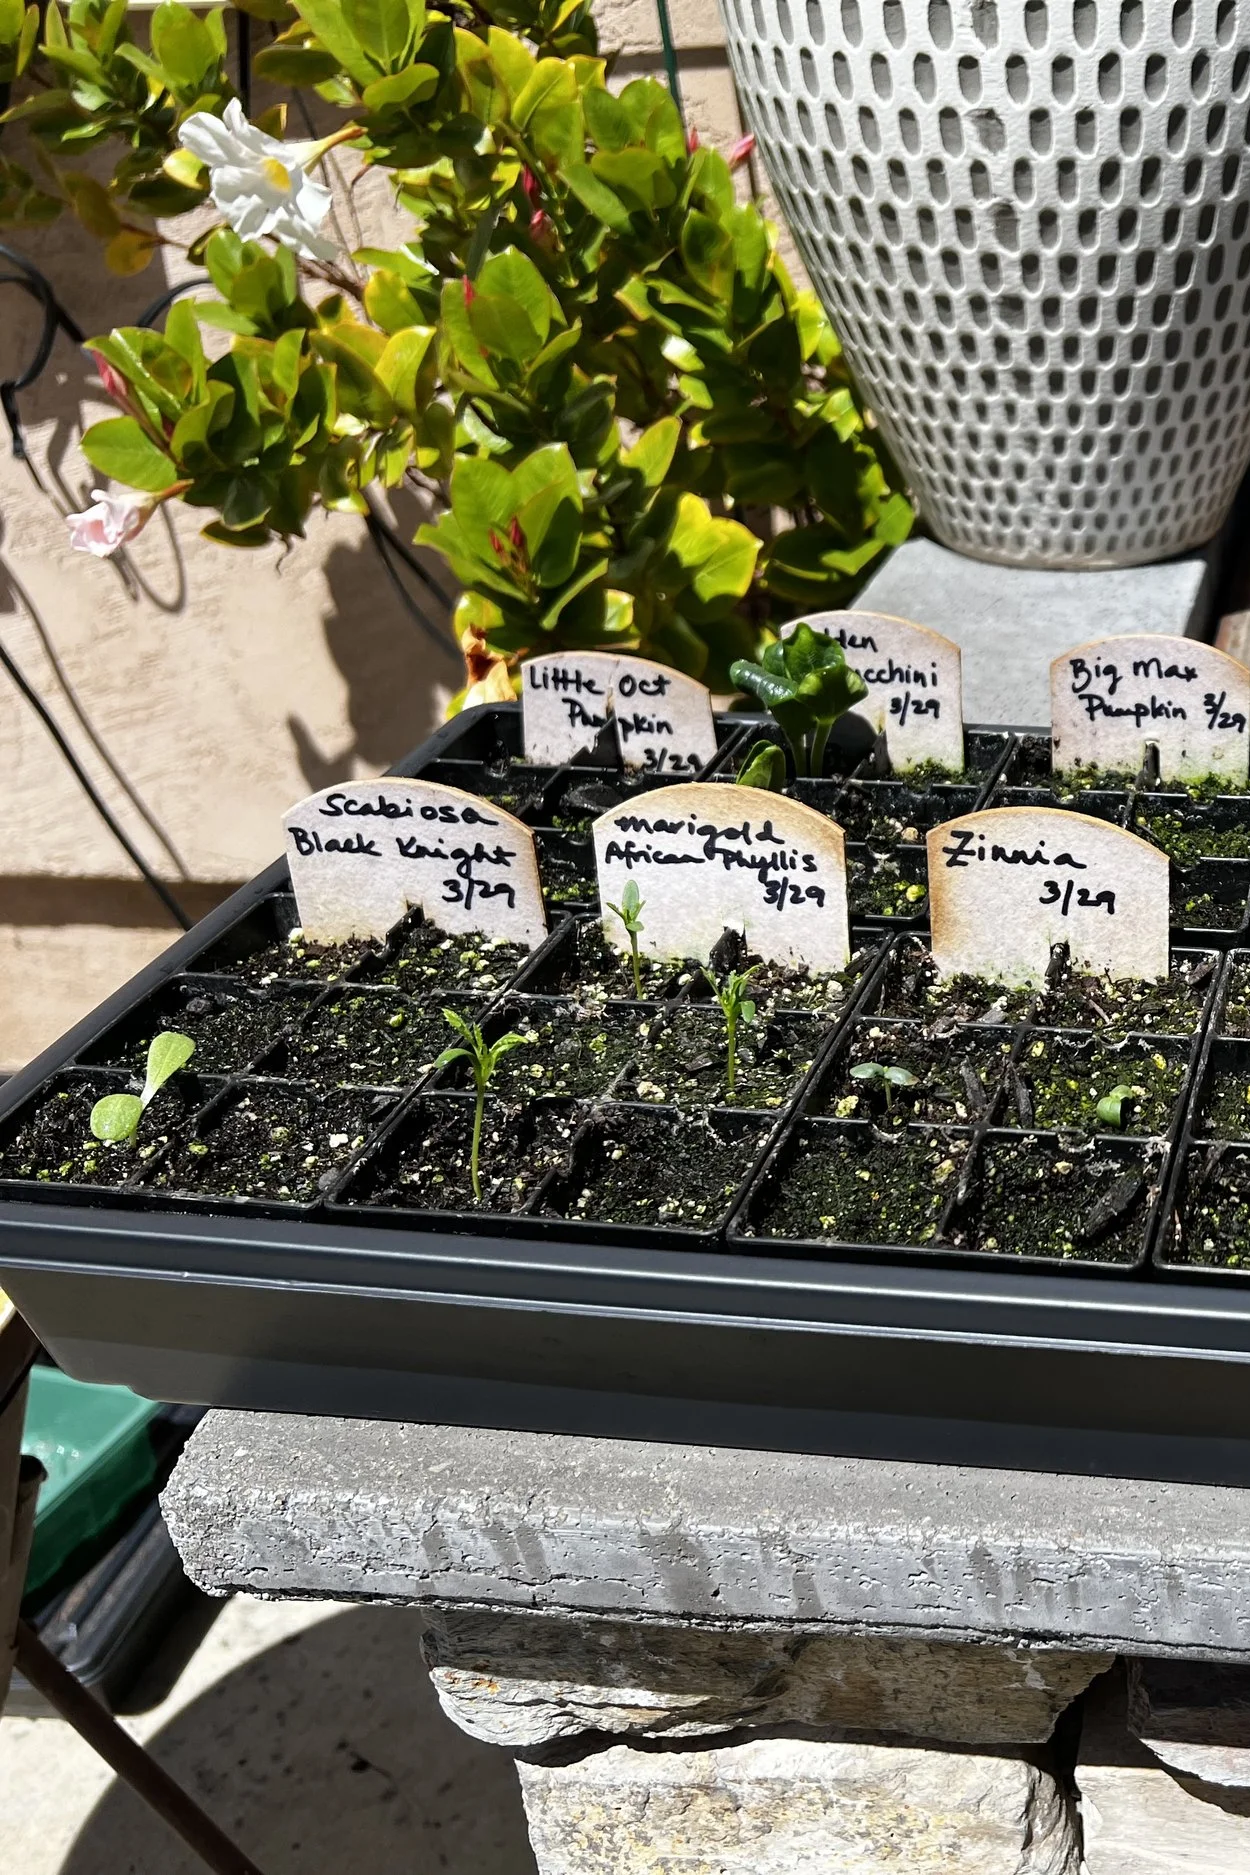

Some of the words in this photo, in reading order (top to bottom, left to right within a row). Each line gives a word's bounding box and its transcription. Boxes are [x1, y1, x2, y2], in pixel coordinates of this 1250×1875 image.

[530, 665, 605, 696] Little
[619, 673, 671, 697] Oct
[1069, 656, 1123, 695] Big
[889, 691, 940, 726] 3/29
[1078, 694, 1187, 728] Pumpkin
[1203, 691, 1247, 733] 3/29
[319, 793, 499, 826] Scabiosa
[288, 827, 382, 856] Black
[396, 836, 517, 879] Knight
[605, 841, 706, 869] African
[942, 831, 1087, 867] Zinnia
[442, 878, 516, 910] 3/29
[763, 876, 826, 911] 3/29
[1039, 880, 1116, 916] 3/29
